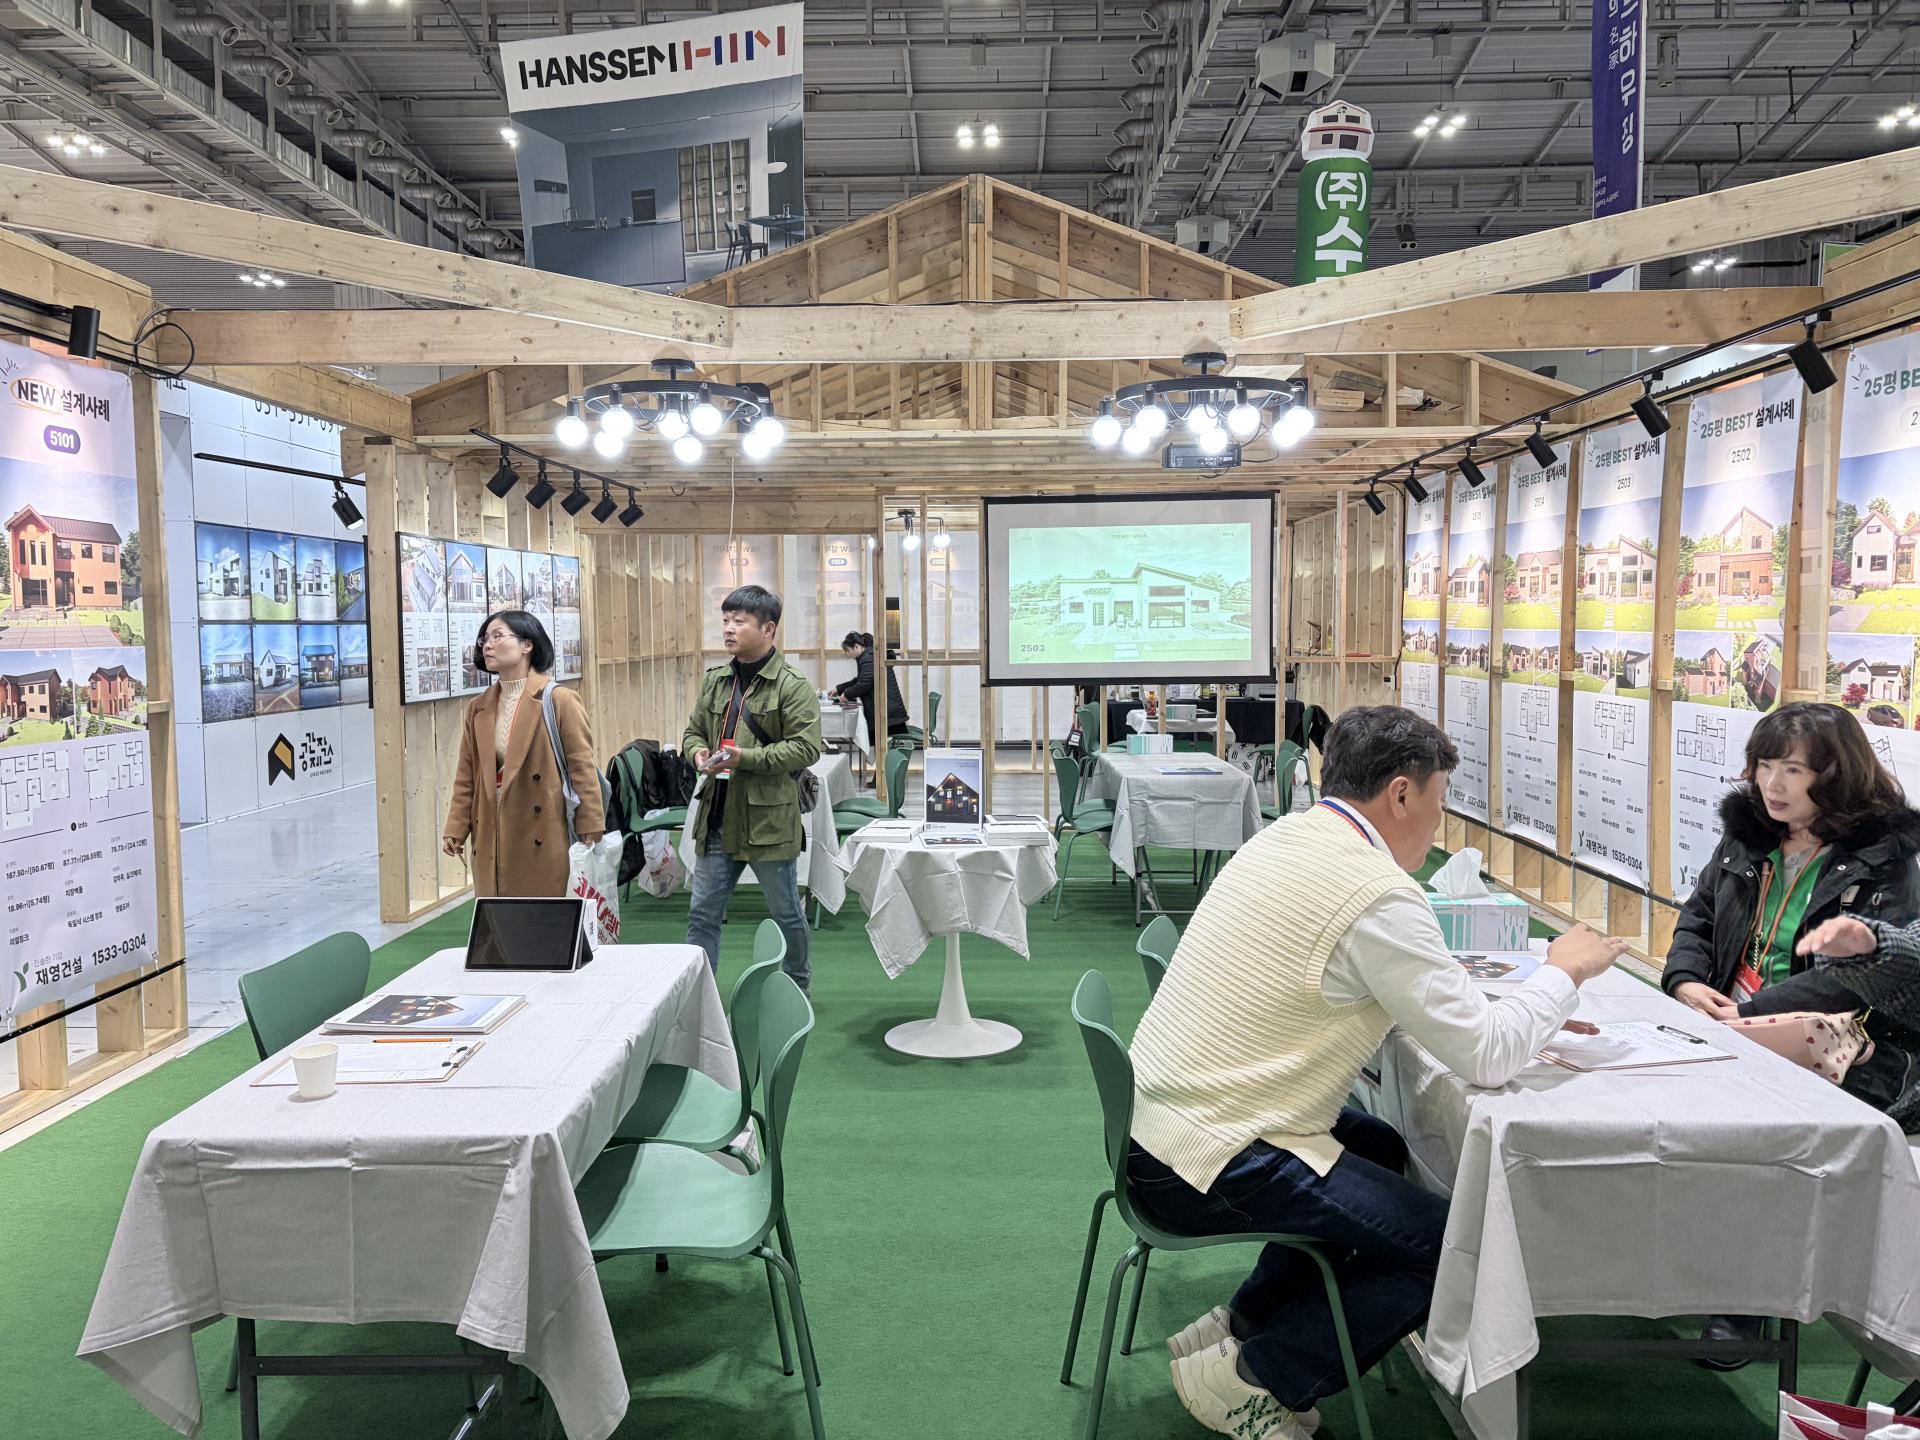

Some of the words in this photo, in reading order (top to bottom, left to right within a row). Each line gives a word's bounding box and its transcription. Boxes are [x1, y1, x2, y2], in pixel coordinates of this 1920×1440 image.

[518, 42, 678, 90] HANSSEM
[1315, 170, 1367, 282] (주)수
[1864, 370, 1897, 398] 25평
[17, 379, 56, 407] NEW
[60, 389, 110, 422] 설계사례
[1700, 416, 1723, 439] 25평
[1725, 411, 1754, 434] BEST
[1755, 398, 1795, 428] 설계사례
[49, 430, 75, 449] 5101
[1595, 450, 1612, 468] 25평
[1612, 446, 1633, 465] BEST
[1634, 436, 1660, 460] 설계사례
[1731, 448, 1751, 463] 2502
[1530, 470, 1546, 486] BEST
[1617, 476, 1631, 490] 2503
[1468, 488, 1481, 501] BEST
[1020, 644, 1046, 653] 2503
[1585, 839, 1608, 857] 재영건설
[1611, 849, 1643, 870] 1533-0304
[34, 956, 83, 986] 재영건설
[91, 933, 147, 966] 1533-0304
